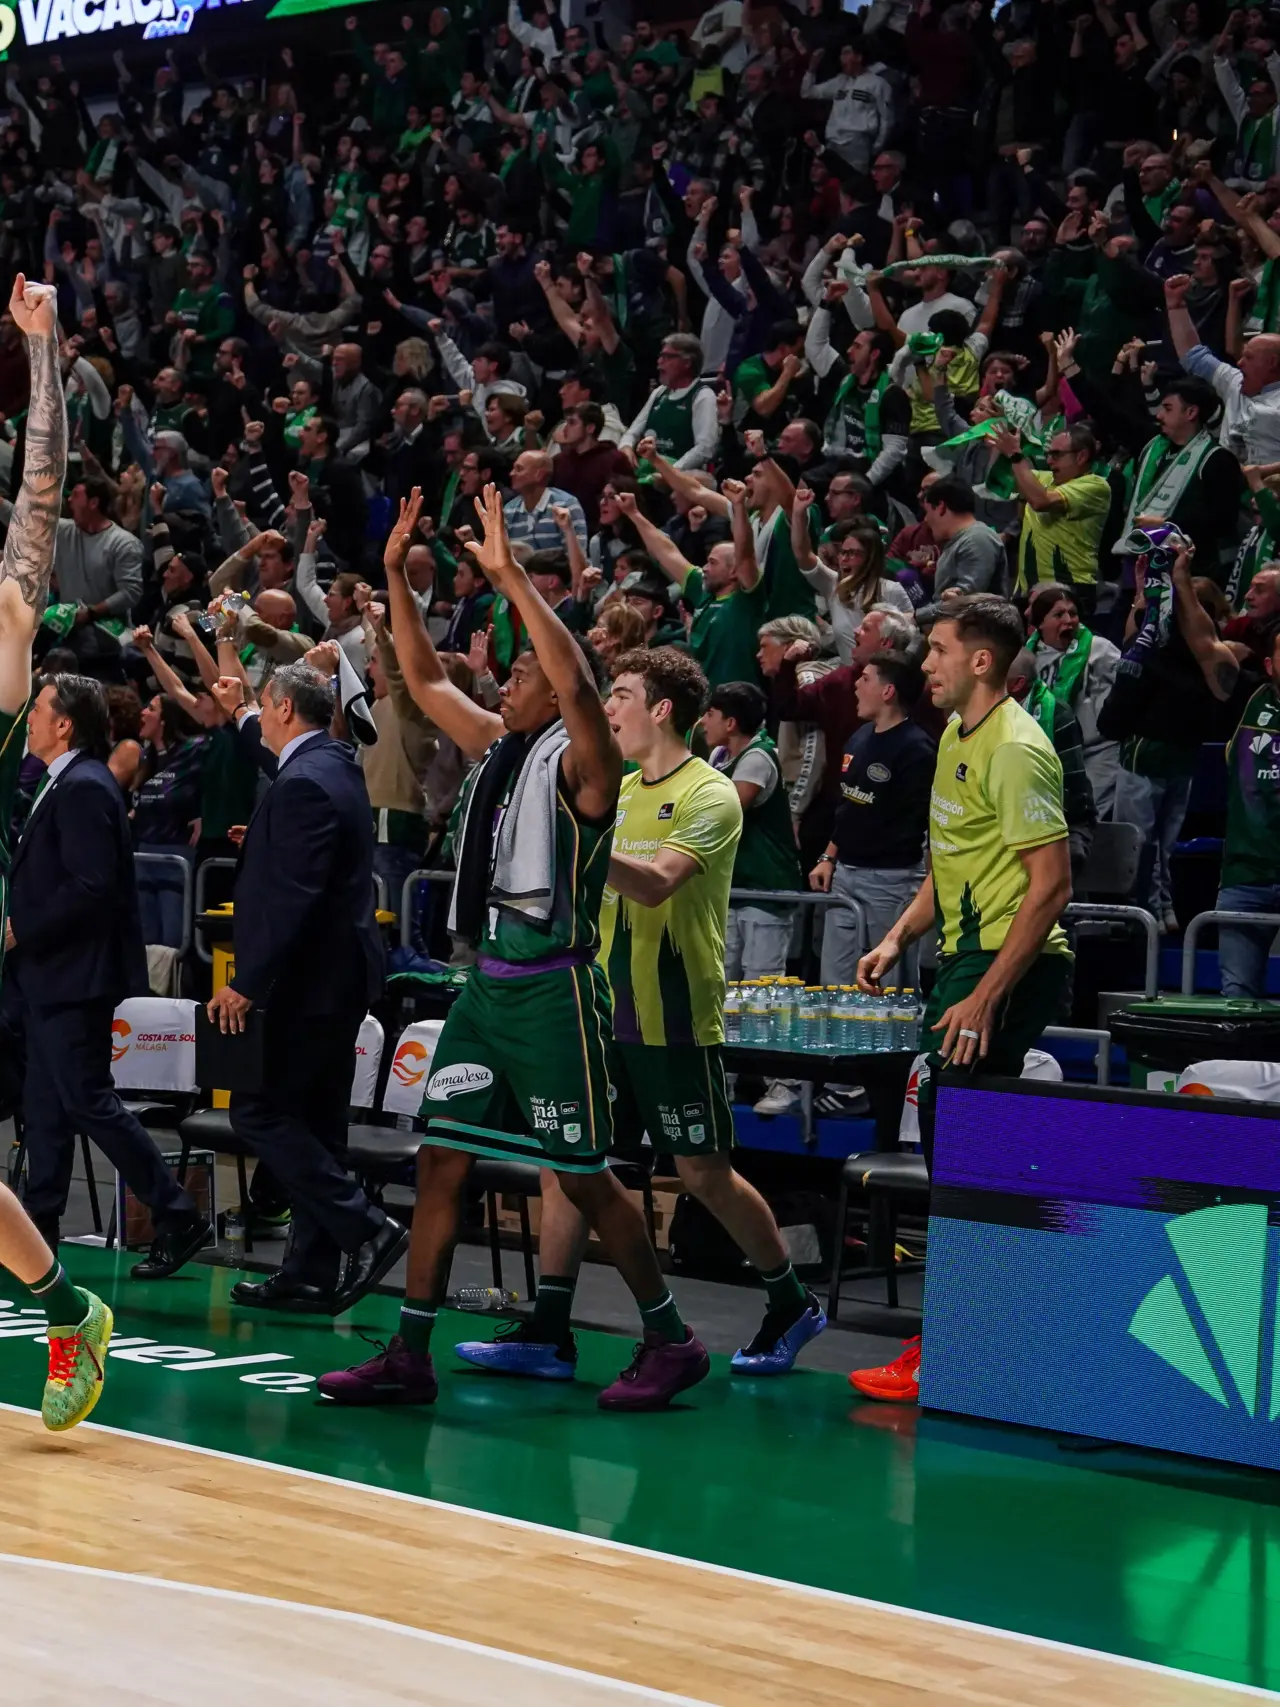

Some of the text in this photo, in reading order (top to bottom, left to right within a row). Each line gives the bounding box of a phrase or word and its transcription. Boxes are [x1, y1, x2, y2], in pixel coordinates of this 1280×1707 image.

[137, 1033, 196, 1043] COSTA DEL SOL
[430, 1066, 490, 1095] famadesa
